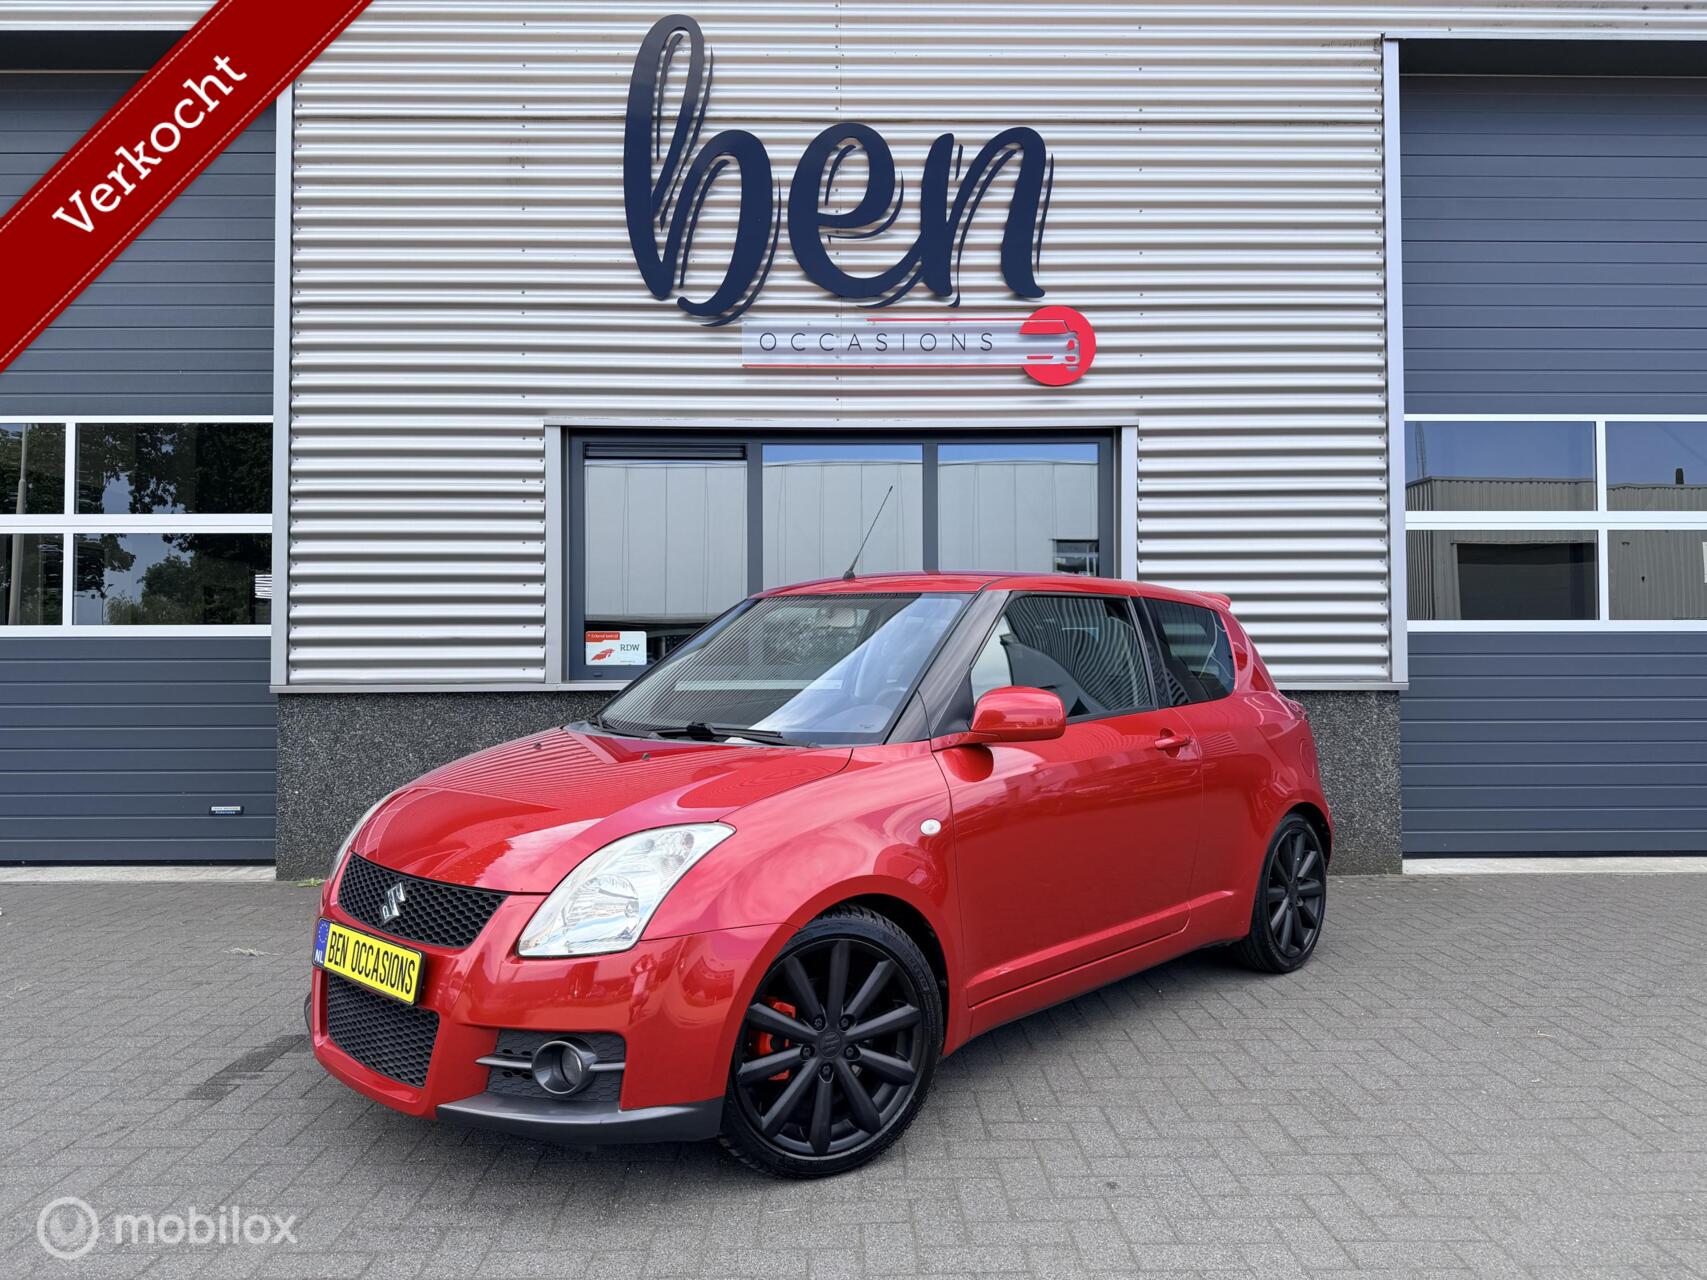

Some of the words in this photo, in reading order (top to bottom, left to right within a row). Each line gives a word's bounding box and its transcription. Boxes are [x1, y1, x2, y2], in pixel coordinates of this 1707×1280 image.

[623, 14, 1053, 326] ben
[759, 331, 994, 353] OCCASIONS
[620, 643, 640, 652] RDW
[314, 948, 324, 964] NL
[327, 930, 349, 969] BEN
[351, 939, 415, 995] OCCASIONS
